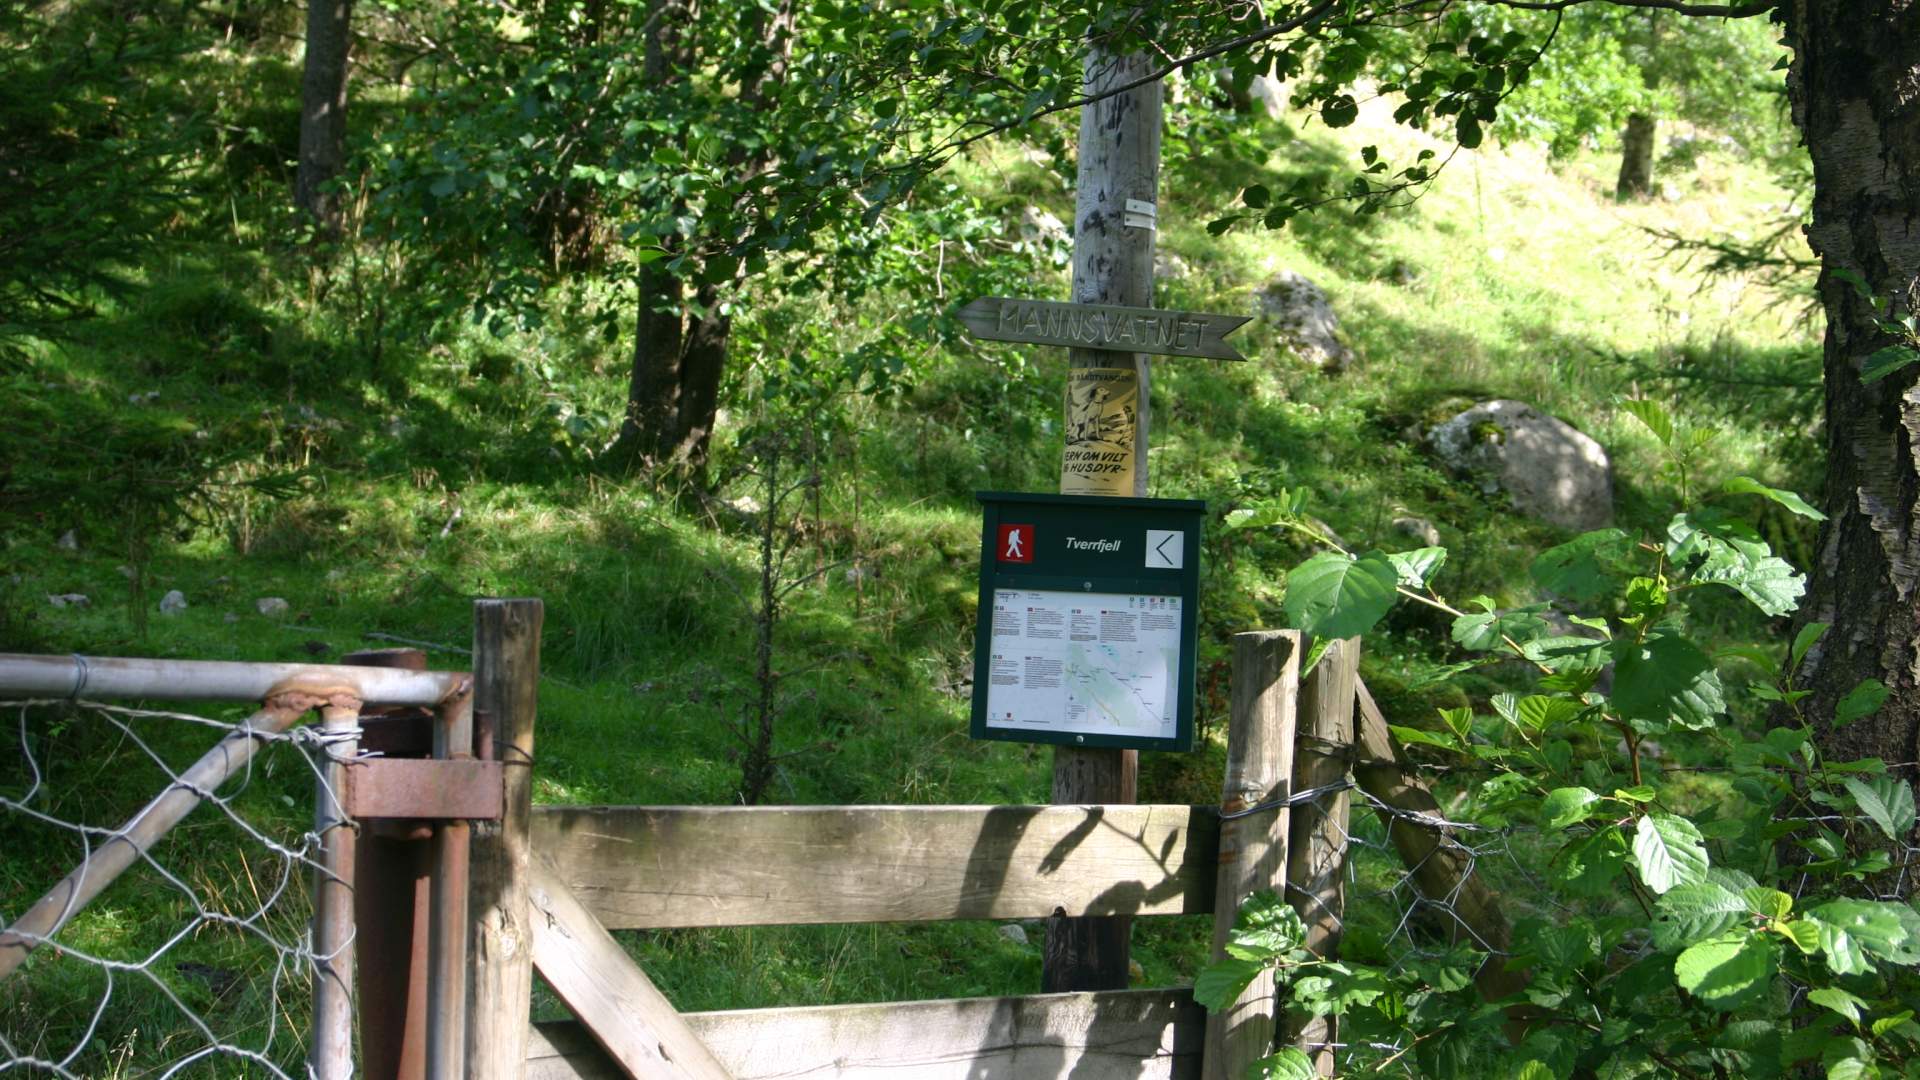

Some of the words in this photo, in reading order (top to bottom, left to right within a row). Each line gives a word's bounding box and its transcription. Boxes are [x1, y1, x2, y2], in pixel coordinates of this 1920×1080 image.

[996, 302, 1210, 351] MANNSVATNET
[1082, 451, 1100, 462] OM
[1101, 451, 1128, 463] VILT
[1066, 536, 1121, 553] Tverrfjell
